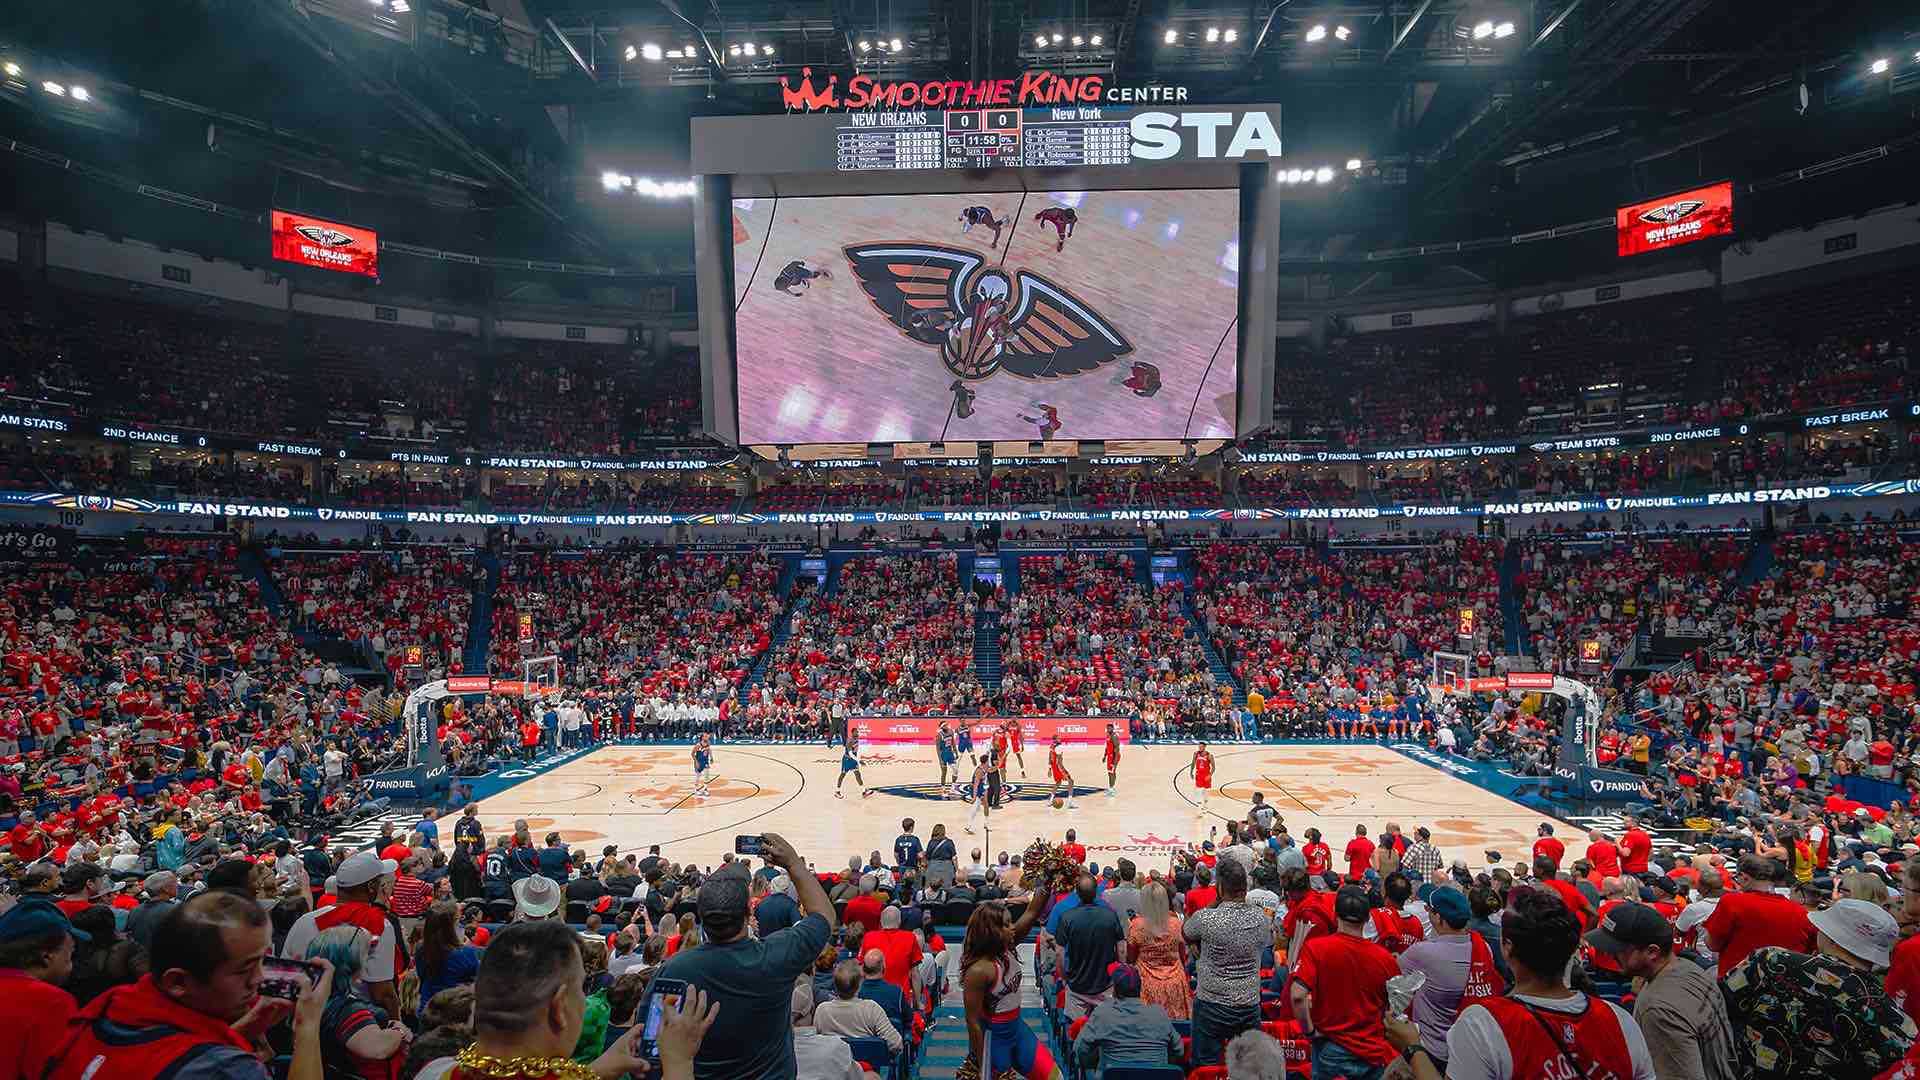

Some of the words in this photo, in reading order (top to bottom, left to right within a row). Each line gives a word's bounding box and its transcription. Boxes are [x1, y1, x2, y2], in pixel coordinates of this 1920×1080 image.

[1107, 87, 1188, 101] CENTER
[852, 112, 877, 126] NEW
[880, 111, 926, 125] ORLEANS
[1052, 108, 1076, 120] New
[1079, 107, 1102, 119] York
[961, 115, 969, 127] 0
[999, 114, 1007, 126] 0
[967, 135, 996, 145] 11:58
[1130, 111, 1282, 160] STA
[1646, 228, 1665, 240] NEW
[1666, 220, 1702, 235] ORLEANS
[301, 245, 319, 256] NEW
[320, 249, 352, 261] ORLEANS
[1805, 414, 1838, 426] FAST
[1841, 408, 1889, 422] BREAK
[23, 417, 67, 431] STATS:
[103, 427, 126, 438] 2ND
[129, 430, 179, 444] CHANCE
[199, 437, 206, 446] 0
[1651, 432, 1672, 443] 2ND
[1674, 427, 1721, 441] CHANCE
[1740, 425, 1748, 434] 0
[1554, 440, 1583, 450] TEAM
[1585, 437, 1620, 448] STATS:
[258, 442, 285, 453] FAST
[287, 445, 322, 457] BREAK
[339, 450, 346, 458] 0
[1376, 451, 1404, 460] FAN
[1407, 448, 1455, 459] STAND
[391, 452, 410, 462] PTS
[412, 454, 421, 463] IN
[423, 454, 449, 464] PAINT
[1259, 453, 1301, 462] STAND
[1328, 453, 1361, 461] FANDUEL
[490, 458, 518, 468] FAN
[520, 459, 567, 470] STAND
[592, 461, 626, 469] FANDUEL
[640, 461, 665, 470] FAN
[667, 460, 708, 469] STAND
[1707, 491, 1751, 505] FAN
[1753, 486, 1831, 503] STAND
[1485, 503, 1519, 515] FAN
[1521, 500, 1583, 514] STAND
[1624, 497, 1678, 508] FANDUEL
[178, 502, 221, 515] FAN
[224, 505, 290, 518] STAND
[335, 511, 383, 520] FANDUEL
[1052, 511, 1090, 519] FANDUEL
[1111, 510, 1139, 520] FAN
[1142, 510, 1190, 520] STAND
[1300, 508, 1329, 518] FAN
[1331, 508, 1379, 518] STAND
[1418, 506, 1462, 516] FANDUEL
[59, 511, 84, 526] 108
[407, 512, 442, 523] FAN
[445, 513, 499, 524] STAND
[532, 515, 574, 523] FANDUEL
[595, 515, 625, 525] FAN
[627, 515, 673, 525] STAND
[779, 513, 806, 523] FAN
[808, 513, 855, 523] STAND
[887, 513, 925, 521] FANDUEL
[944, 512, 973, 522] FAN
[975, 511, 1022, 521] STAND
[32, 533, 57, 548] Go
[1574, 716, 1583, 743] ibotta
[375, 780, 416, 790] FANDUEL
